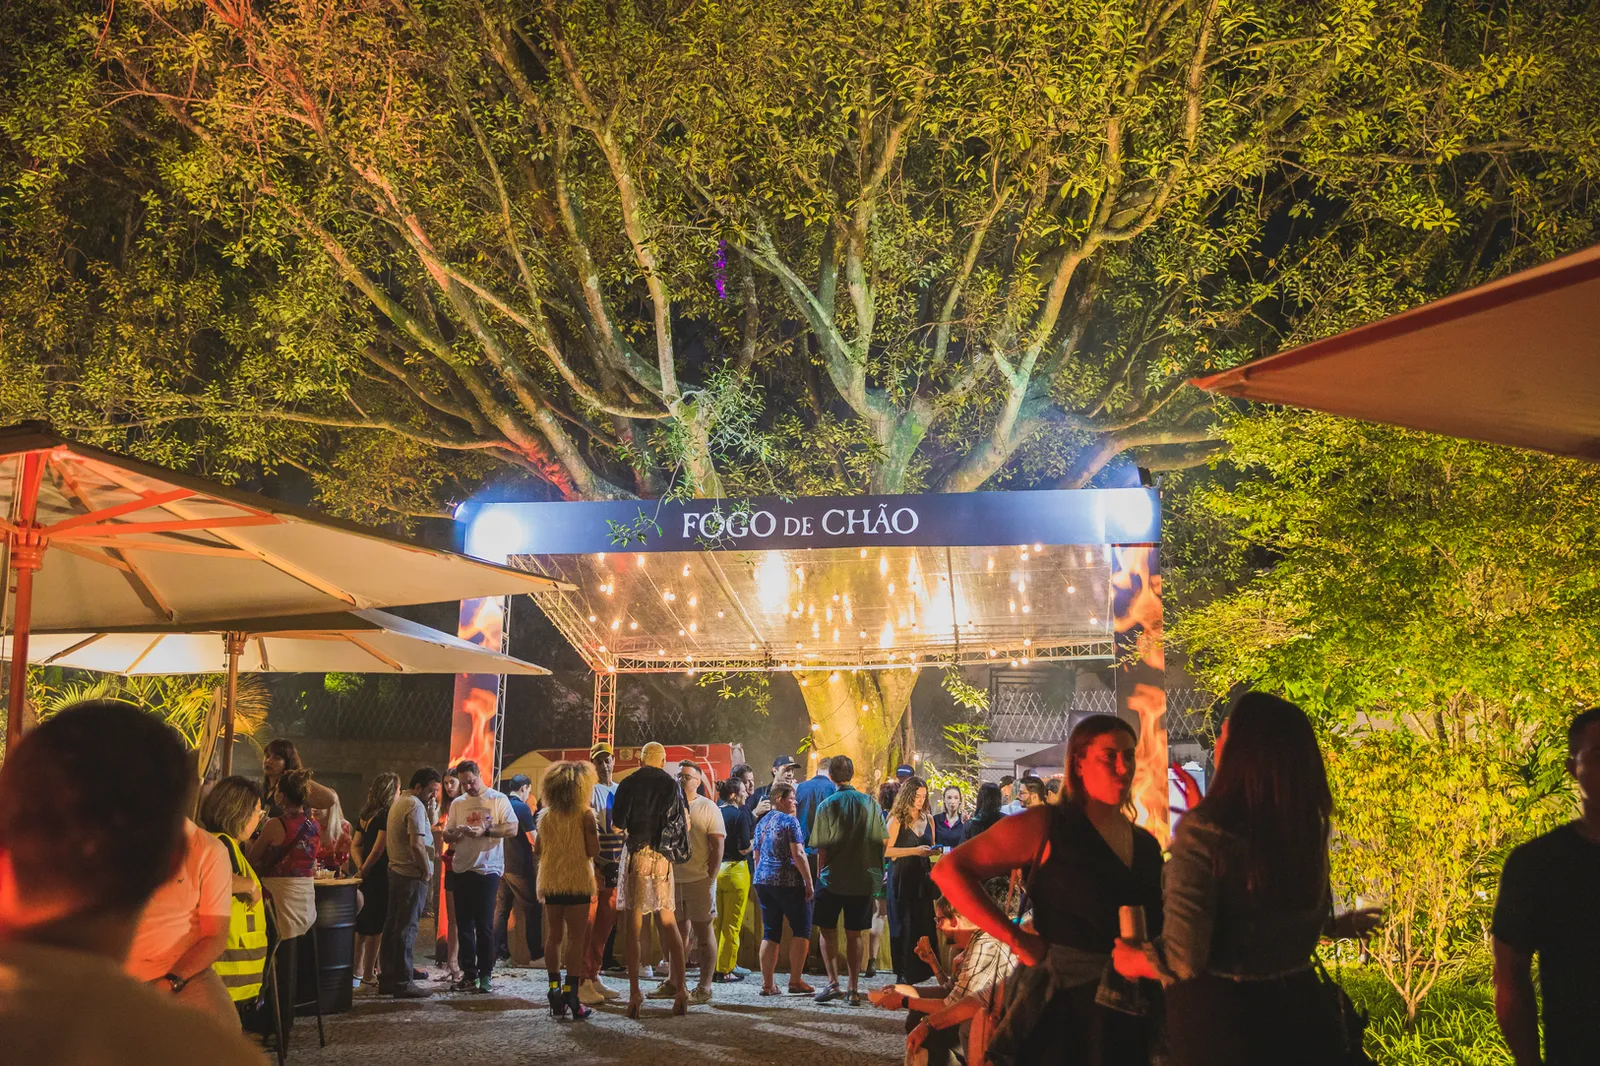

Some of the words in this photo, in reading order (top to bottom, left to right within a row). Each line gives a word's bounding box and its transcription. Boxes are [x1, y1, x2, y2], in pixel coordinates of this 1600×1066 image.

[682, 511, 777, 538] FOGO
[783, 516, 814, 536] DE
[821, 503, 919, 535] CHÃO
